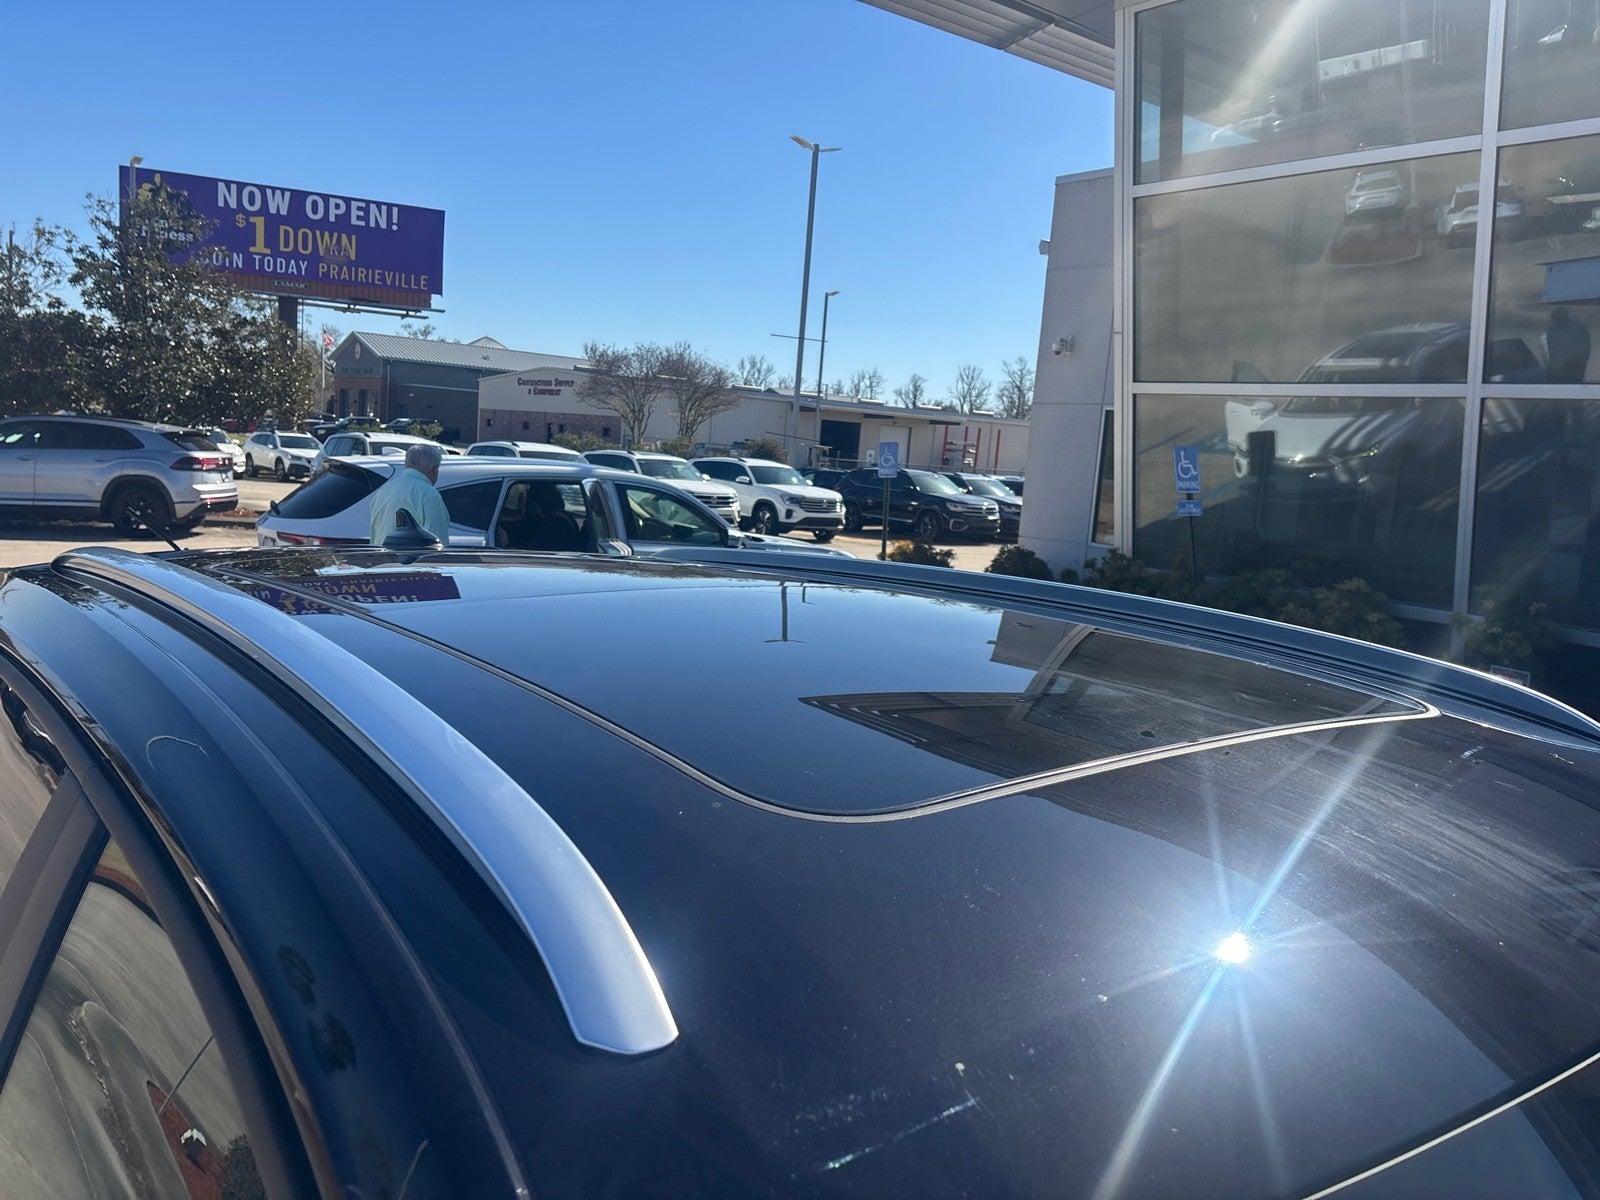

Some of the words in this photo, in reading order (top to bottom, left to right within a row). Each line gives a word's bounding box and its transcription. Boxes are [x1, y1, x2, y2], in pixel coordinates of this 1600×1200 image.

[218, 181, 291, 215] NOW
[305, 195, 399, 231] OPEN!
[279, 224, 357, 260] DOWN
[203, 250, 243, 269] OIN
[252, 254, 308, 276] TODAY
[318, 262, 429, 290] PRAIRIEVILLE
